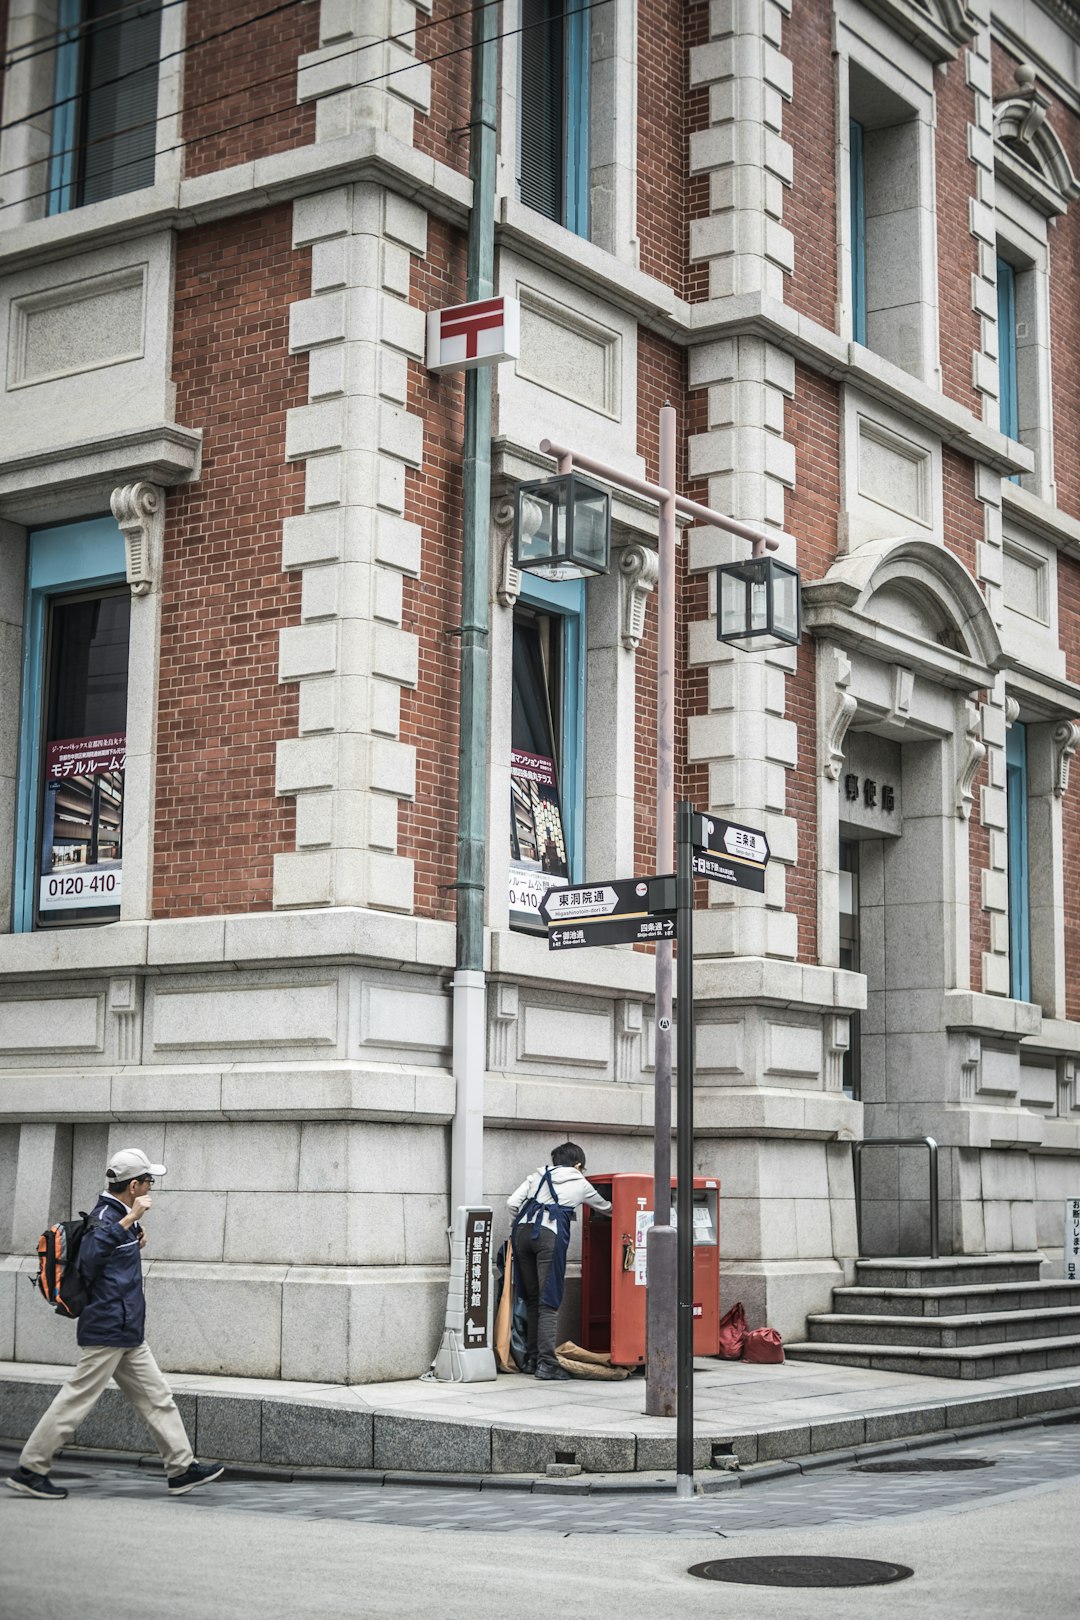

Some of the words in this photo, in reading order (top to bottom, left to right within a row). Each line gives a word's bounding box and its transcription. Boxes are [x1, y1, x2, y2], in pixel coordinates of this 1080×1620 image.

[736, 832, 755, 848] 三条通
[49, 874, 121, 896] 0120-410-
[559, 890, 604, 906] 東洞院通
[555, 907, 600, 917] Higashinotoin-dori
[563, 930, 584, 940] 御池通
[641, 922, 662, 932] 四条通
[471, 1236, 483, 1307] 壁面博物館
[1068, 1263, 1075, 1280] 日本
